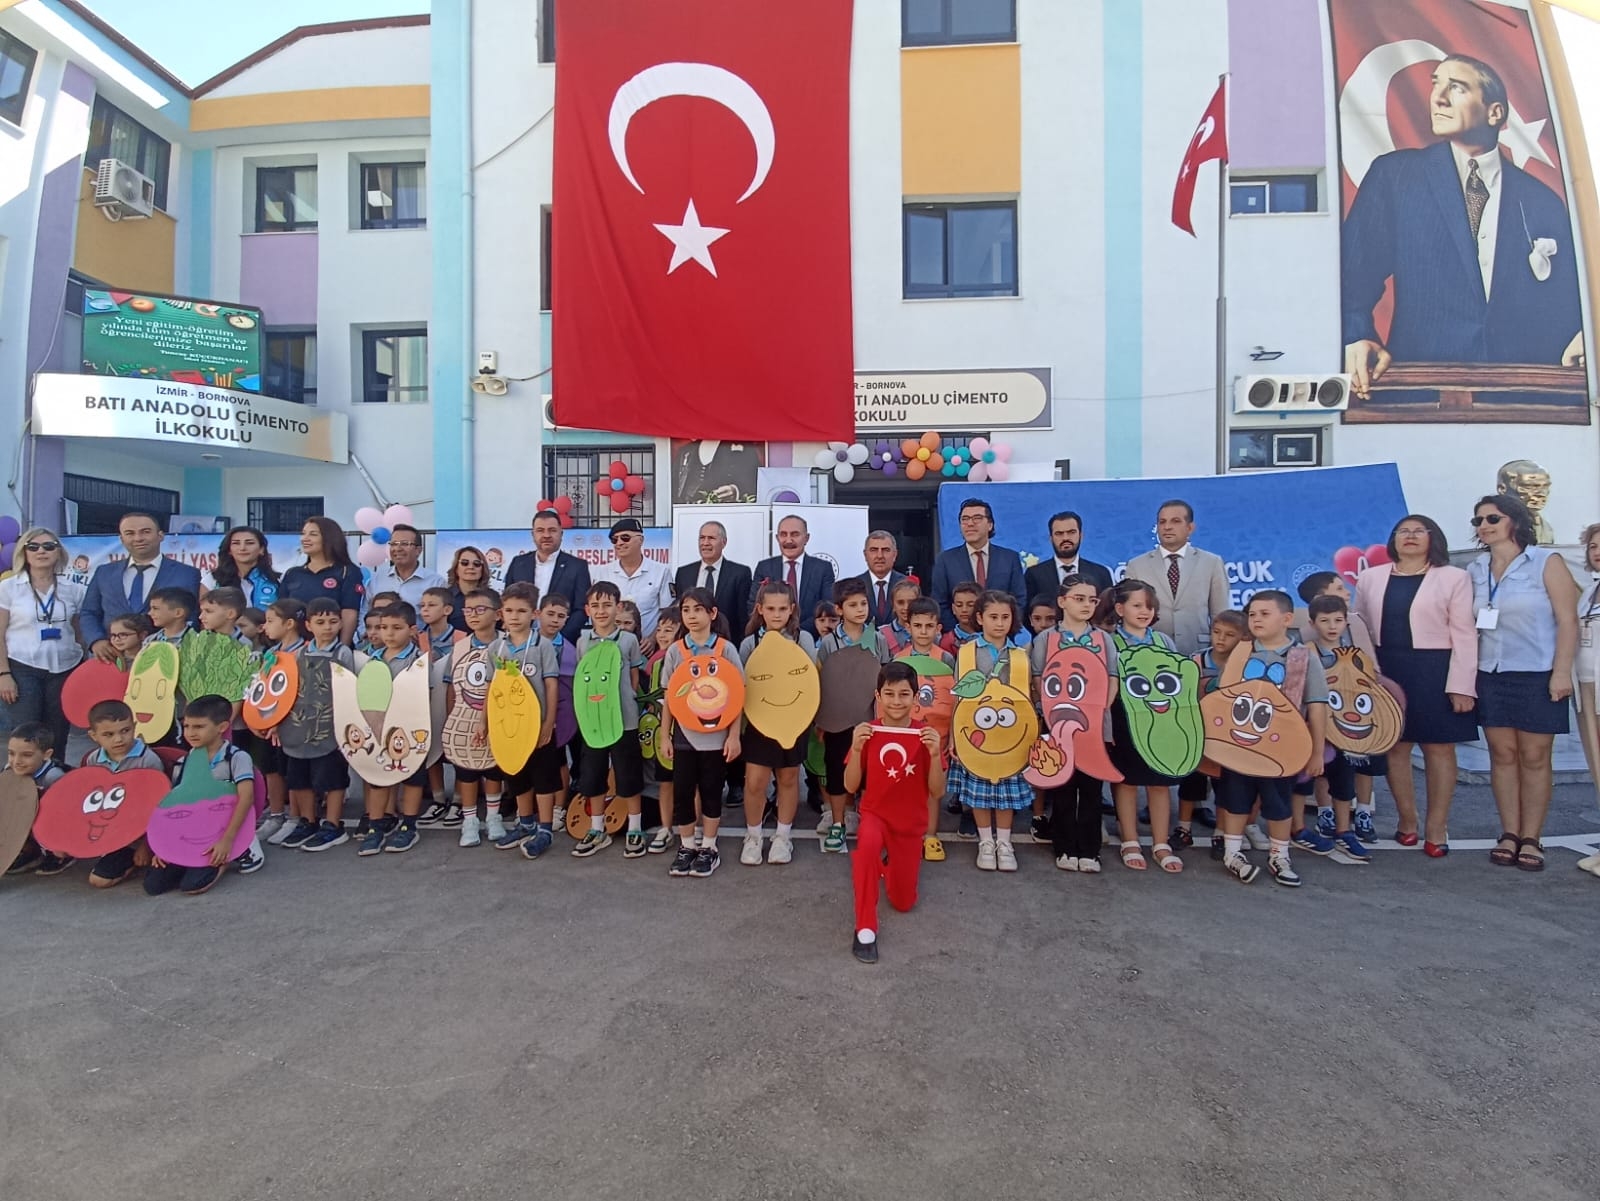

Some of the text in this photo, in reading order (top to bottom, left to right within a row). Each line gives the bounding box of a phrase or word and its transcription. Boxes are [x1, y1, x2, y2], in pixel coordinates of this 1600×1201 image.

[101, 322, 142, 333] yılında
[146, 325, 170, 335] tüm
[174, 329, 230, 344] öğretmen
[114, 316, 234, 337] Yeni eğitim-öğretim
[100, 328, 248, 352] öğrencilerimize başarılar
[153, 340, 195, 351] dileriz.
[156, 384, 188, 397] İZMİR
[198, 390, 251, 406] BORNOVA
[866, 382, 906, 390] BORNOVA
[871, 393, 939, 406] ANADOLU
[943, 390, 1009, 406] ÇİMENTO
[85, 395, 309, 435] BATI ANADOLU ÇİMENTO
[155, 417, 253, 443] İLKOKULU
